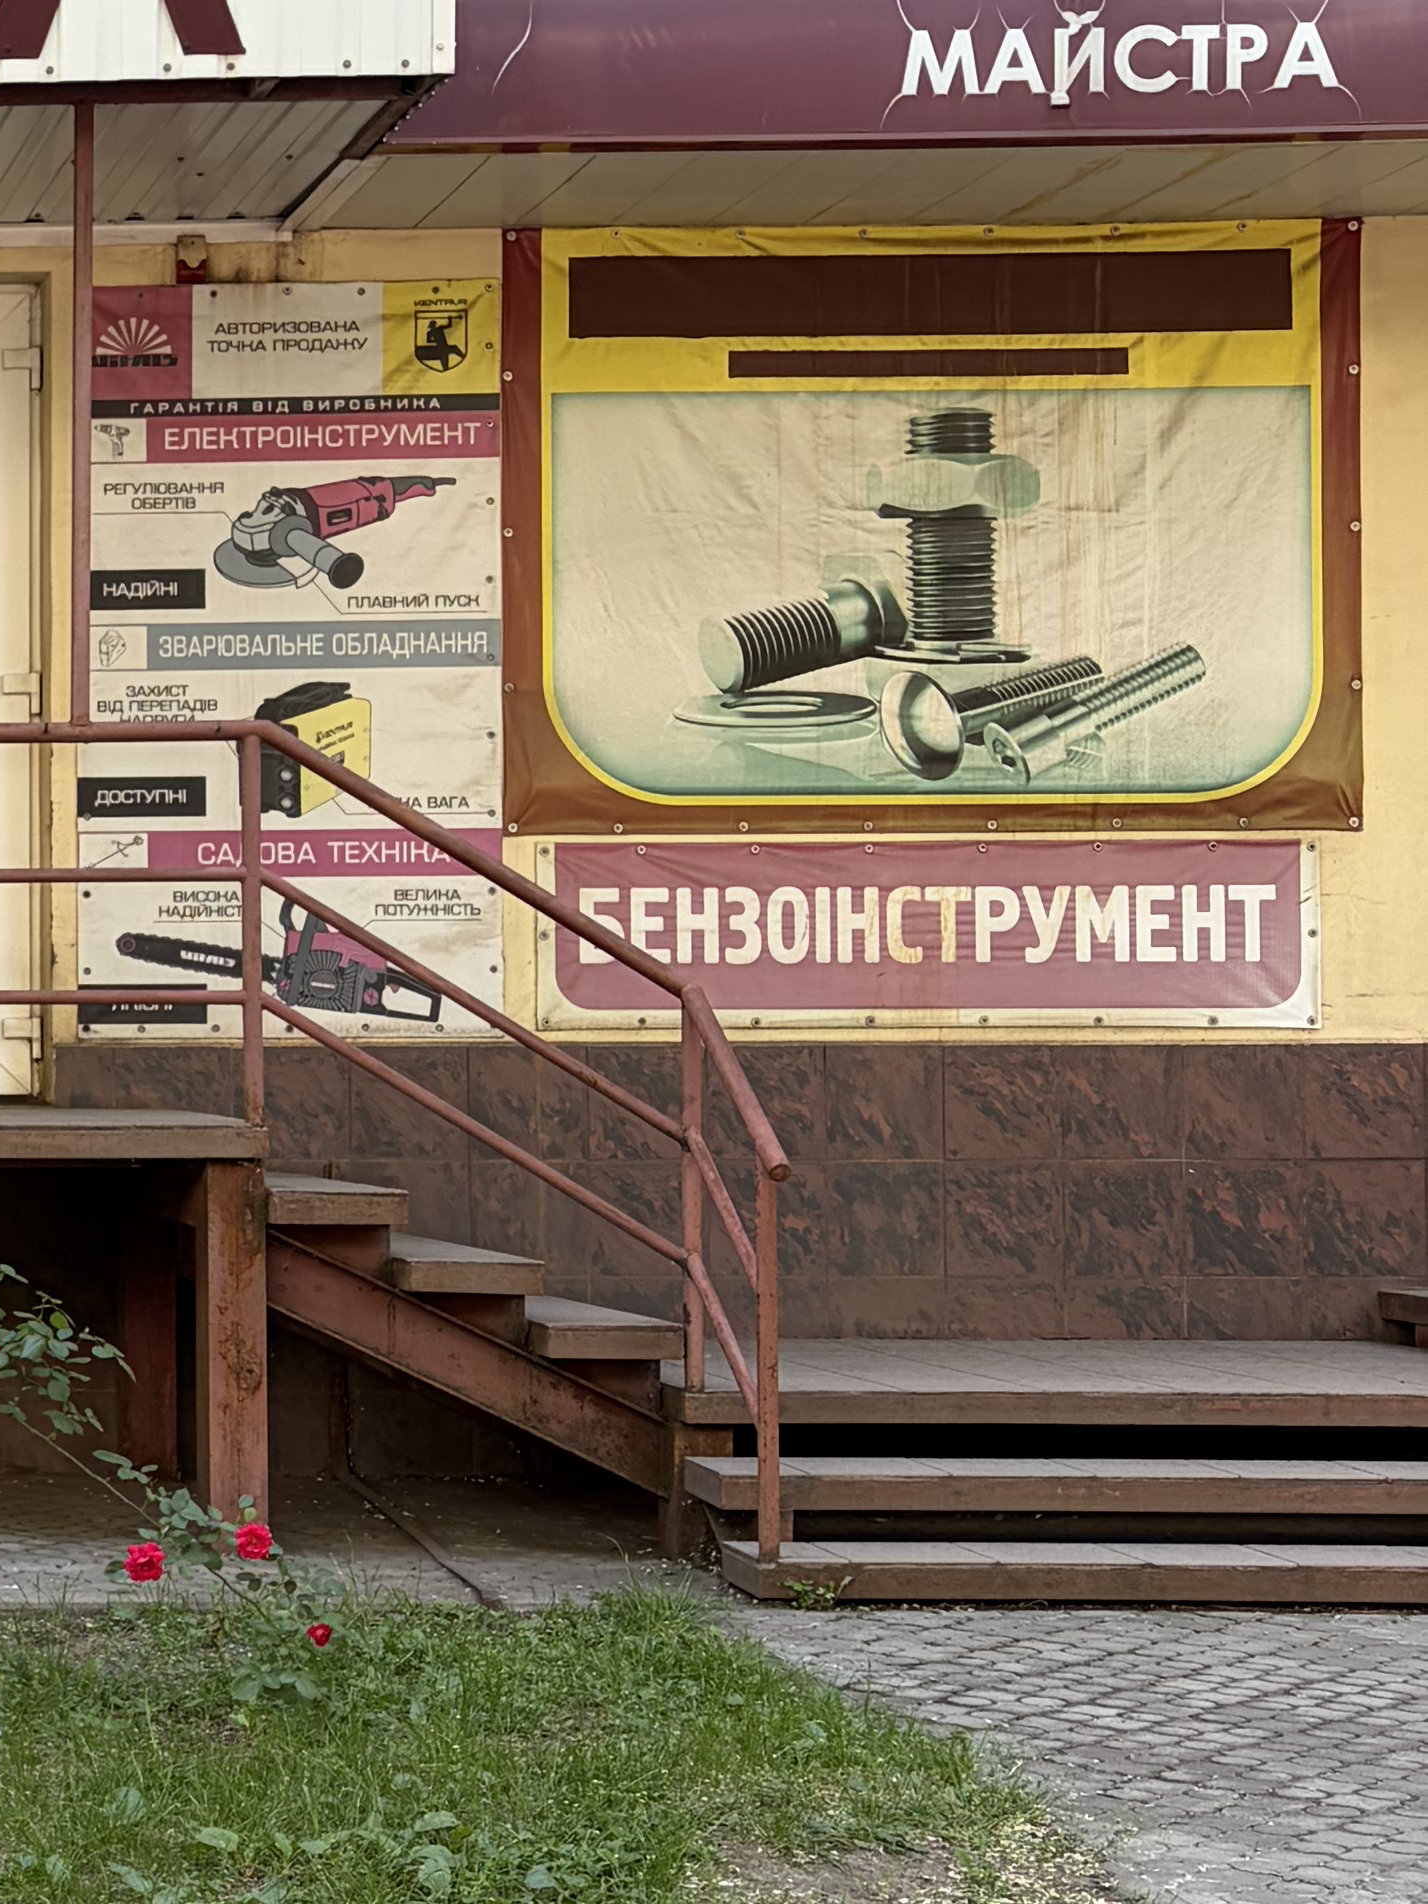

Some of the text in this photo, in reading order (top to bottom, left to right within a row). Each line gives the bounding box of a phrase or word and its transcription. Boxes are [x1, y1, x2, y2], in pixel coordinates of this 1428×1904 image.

[899, 10, 1340, 108] МАЙСТРА
[214, 320, 360, 335] АВТОРИЗОВАНА
[206, 337, 368, 354] ТОЧКА ПРОДАЖУ
[129, 396, 442, 415] ГАРАНТІЯ ВІД ВИРОБНИКА
[163, 422, 481, 451] ЕЛЕКТРОІНСТРУМЕНТ
[103, 481, 224, 496] РЕГУЛЮВАННЯ
[131, 497, 197, 510] ОБЕРТІВ
[102, 580, 178, 600] НАДІЙНІ
[347, 593, 480, 609] ПЛАВНИЙ ПУСК
[158, 631, 488, 660] ЗВАРЮВАЛЬНЕ ОБЛАДНАННЯ
[125, 684, 189, 698] ЗАХИСТ
[97, 699, 218, 715] ВІД ПЕРЕПАДІВ
[94, 788, 187, 807] ДОСТУПНІ
[427, 796, 470, 809] ВАГА
[328, 840, 451, 864] ТЕХНІКА
[172, 890, 240, 903] ВИСОКА
[393, 888, 461, 902] ВЕЛИКА
[158, 903, 243, 919] НАДІЙНІСТ
[375, 902, 482, 917] ПОТУЖНІСТЬ
[578, 883, 1278, 966] БЕНЗОІНСТРУМЕНТ
